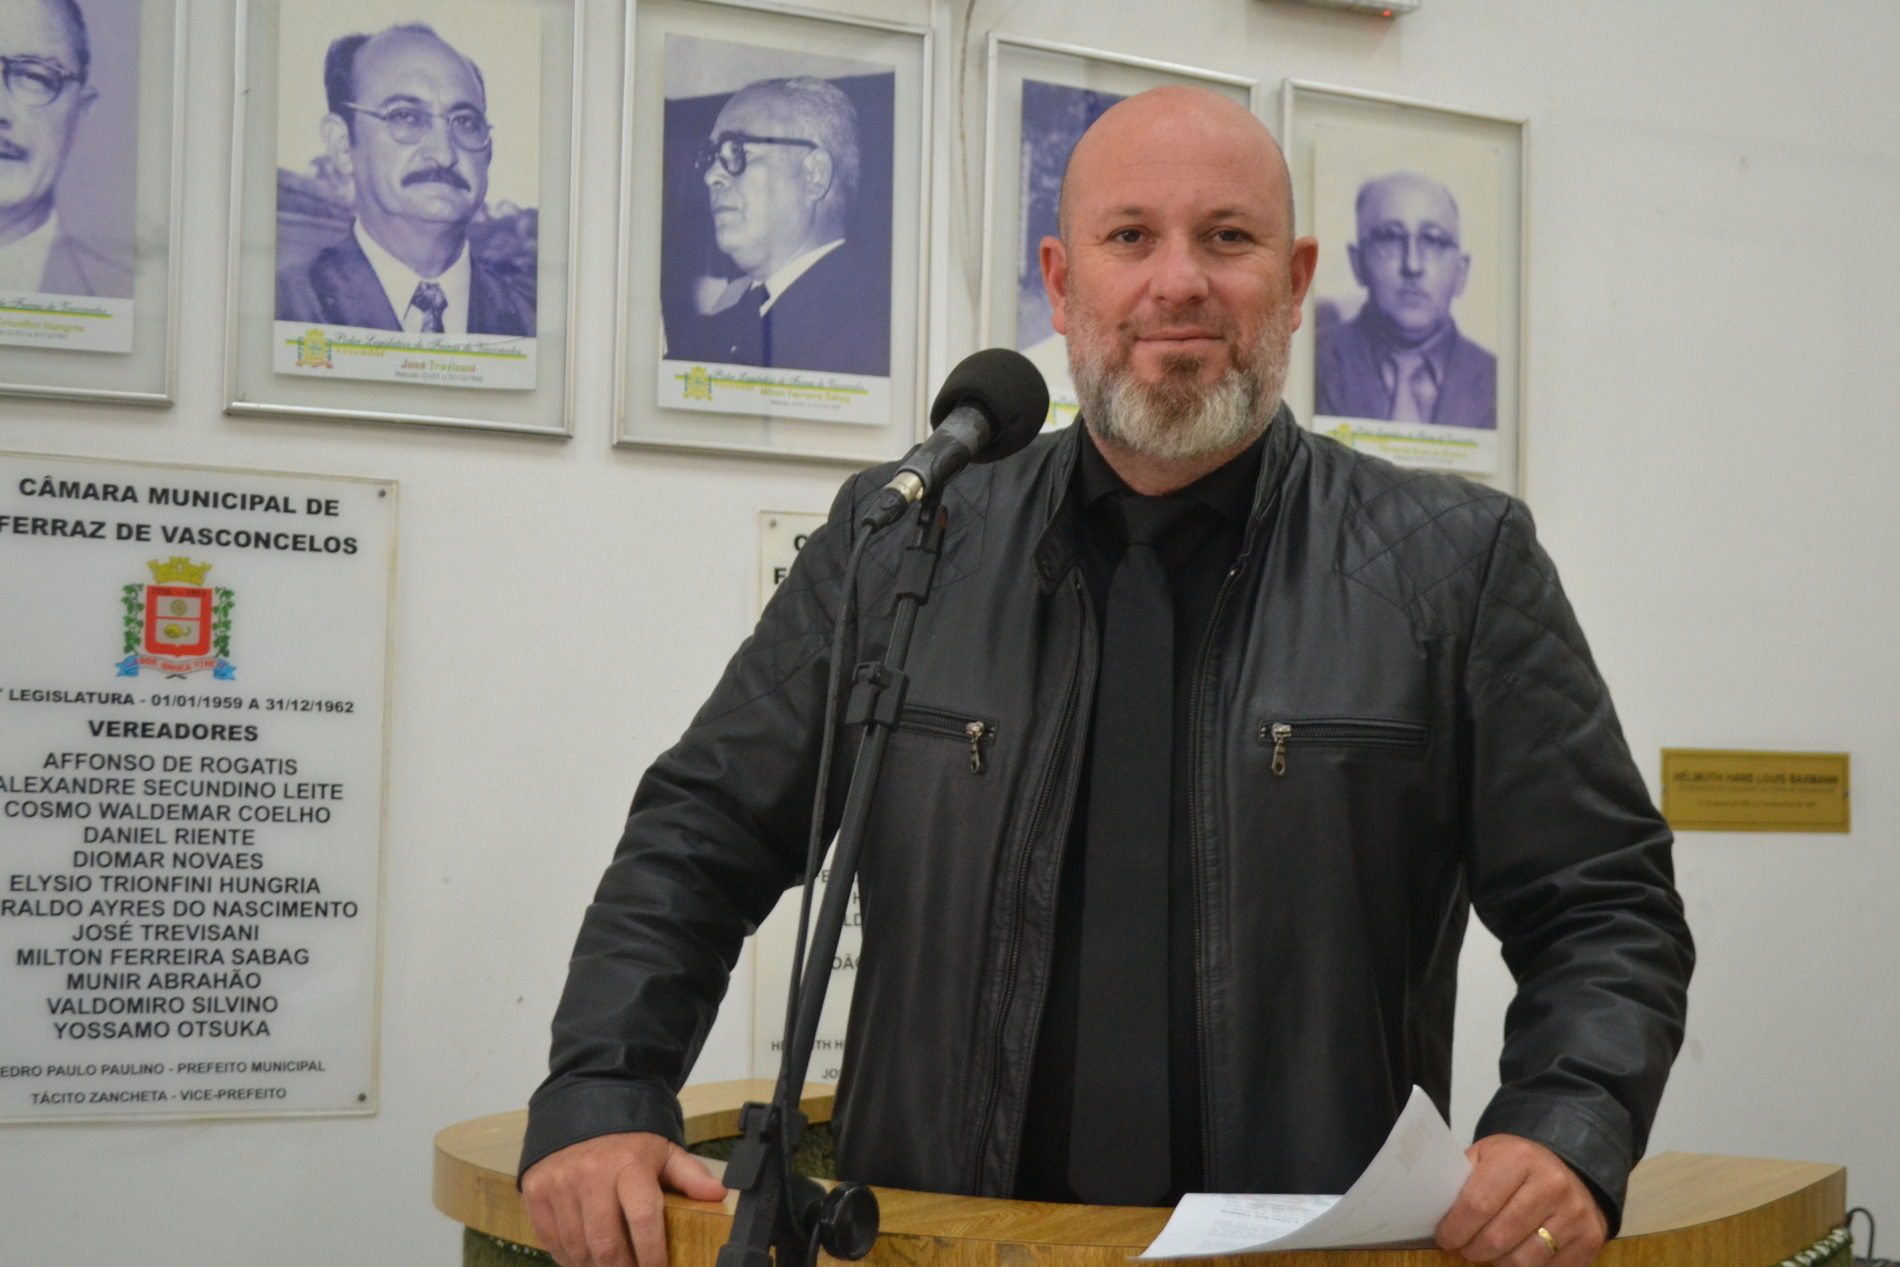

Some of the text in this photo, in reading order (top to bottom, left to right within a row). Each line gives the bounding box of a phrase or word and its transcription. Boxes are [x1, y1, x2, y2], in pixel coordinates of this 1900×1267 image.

[19, 476, 339, 516] CÂMARA MUNICIPAL DE
[0, 515, 358, 555] FERRAZ DE VASCONCELOS
[9, 689, 134, 705] LEGISLATURA
[151, 694, 243, 709] 01/01/1959
[248, 698, 260, 709] A
[266, 698, 354, 713] 31/12/1962
[88, 720, 258, 742] VEREADORES
[43, 752, 297, 775] AFFONSO DE ROGATIS
[143, 779, 276, 798] SECUNDINO
[284, 783, 343, 800] LEITE
[4, 800, 330, 823] COSMO WALDEMAR COELHO
[84, 827, 254, 846] DANIEL RIENTE
[73, 851, 263, 870] DIOMAR NOVAES
[10, 875, 320, 894] ELYSIO TRIONFINI HUNGRIA
[1, 899, 358, 918] RALDO AYRES DO NASCIMENTO
[72, 920, 259, 941] JOSÉ TREVISANI
[16, 948, 309, 966] MILTON FERREIRA SABAG
[67, 969, 261, 990] MUNIR ABRAHÃO
[47, 996, 278, 1015] VALDOMIRO SILVINO
[54, 1020, 270, 1039] YOSSAMO OTSUKA
[0, 1065, 42, 1078] EDRO
[46, 1064, 97, 1076] PAULO
[101, 1063, 164, 1075] PAULINO
[177, 1062, 247, 1074] PREFEITO
[251, 1061, 325, 1073] MUNICIPAL
[31, 1089, 86, 1104] TÁCITO
[89, 1090, 168, 1103] ZANCHETA
[180, 1088, 286, 1101] VICE-PREFEITO
